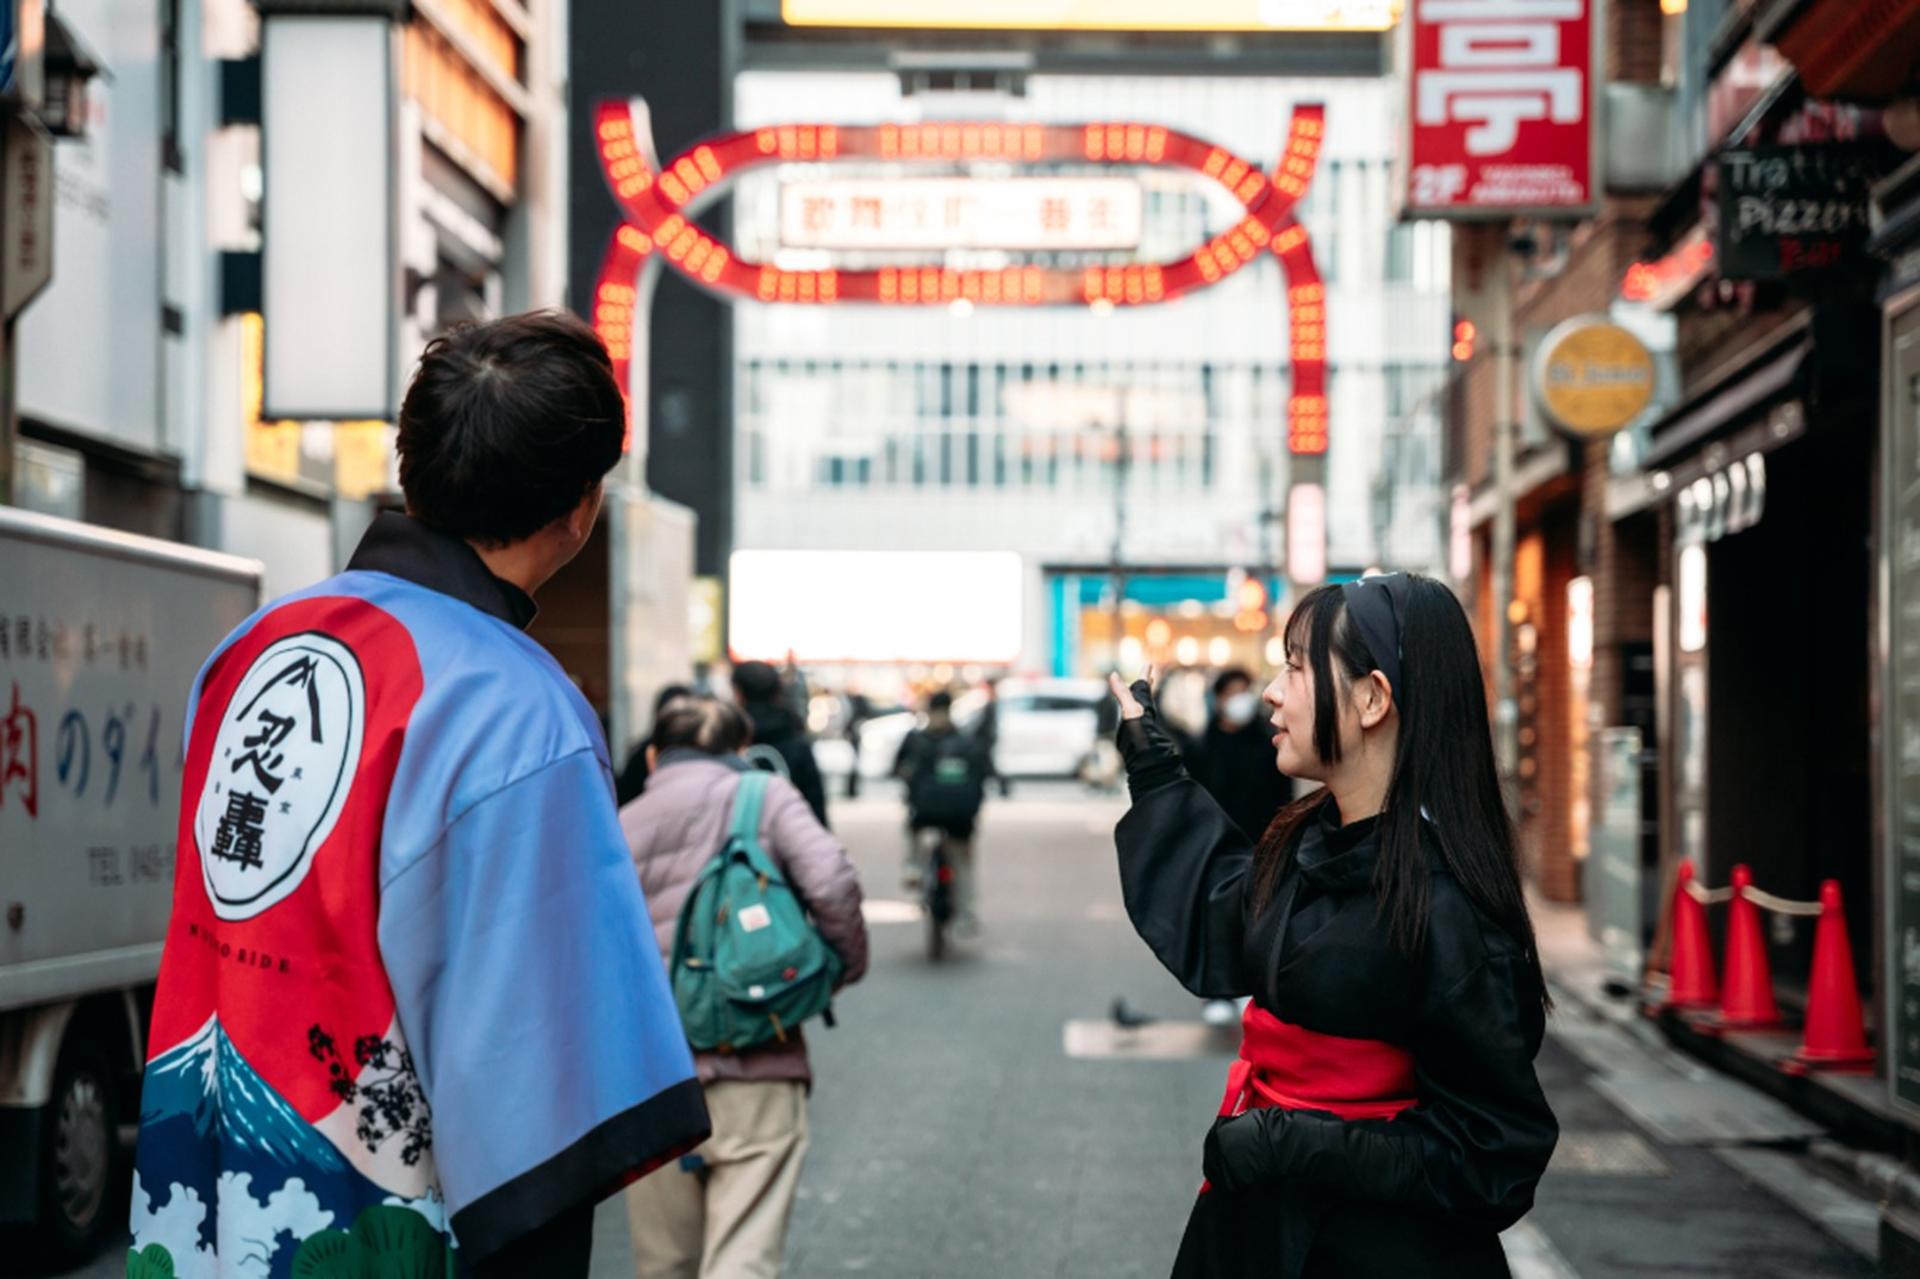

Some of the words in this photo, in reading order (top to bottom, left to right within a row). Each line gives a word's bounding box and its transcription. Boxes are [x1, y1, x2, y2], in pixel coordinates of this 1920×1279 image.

[1413, 164, 1467, 205] 2F
[801, 195, 1120, 233] 歌舞番街
[0, 680, 186, 820] 肉のダイ
[238, 948, 290, 973] RIDE
